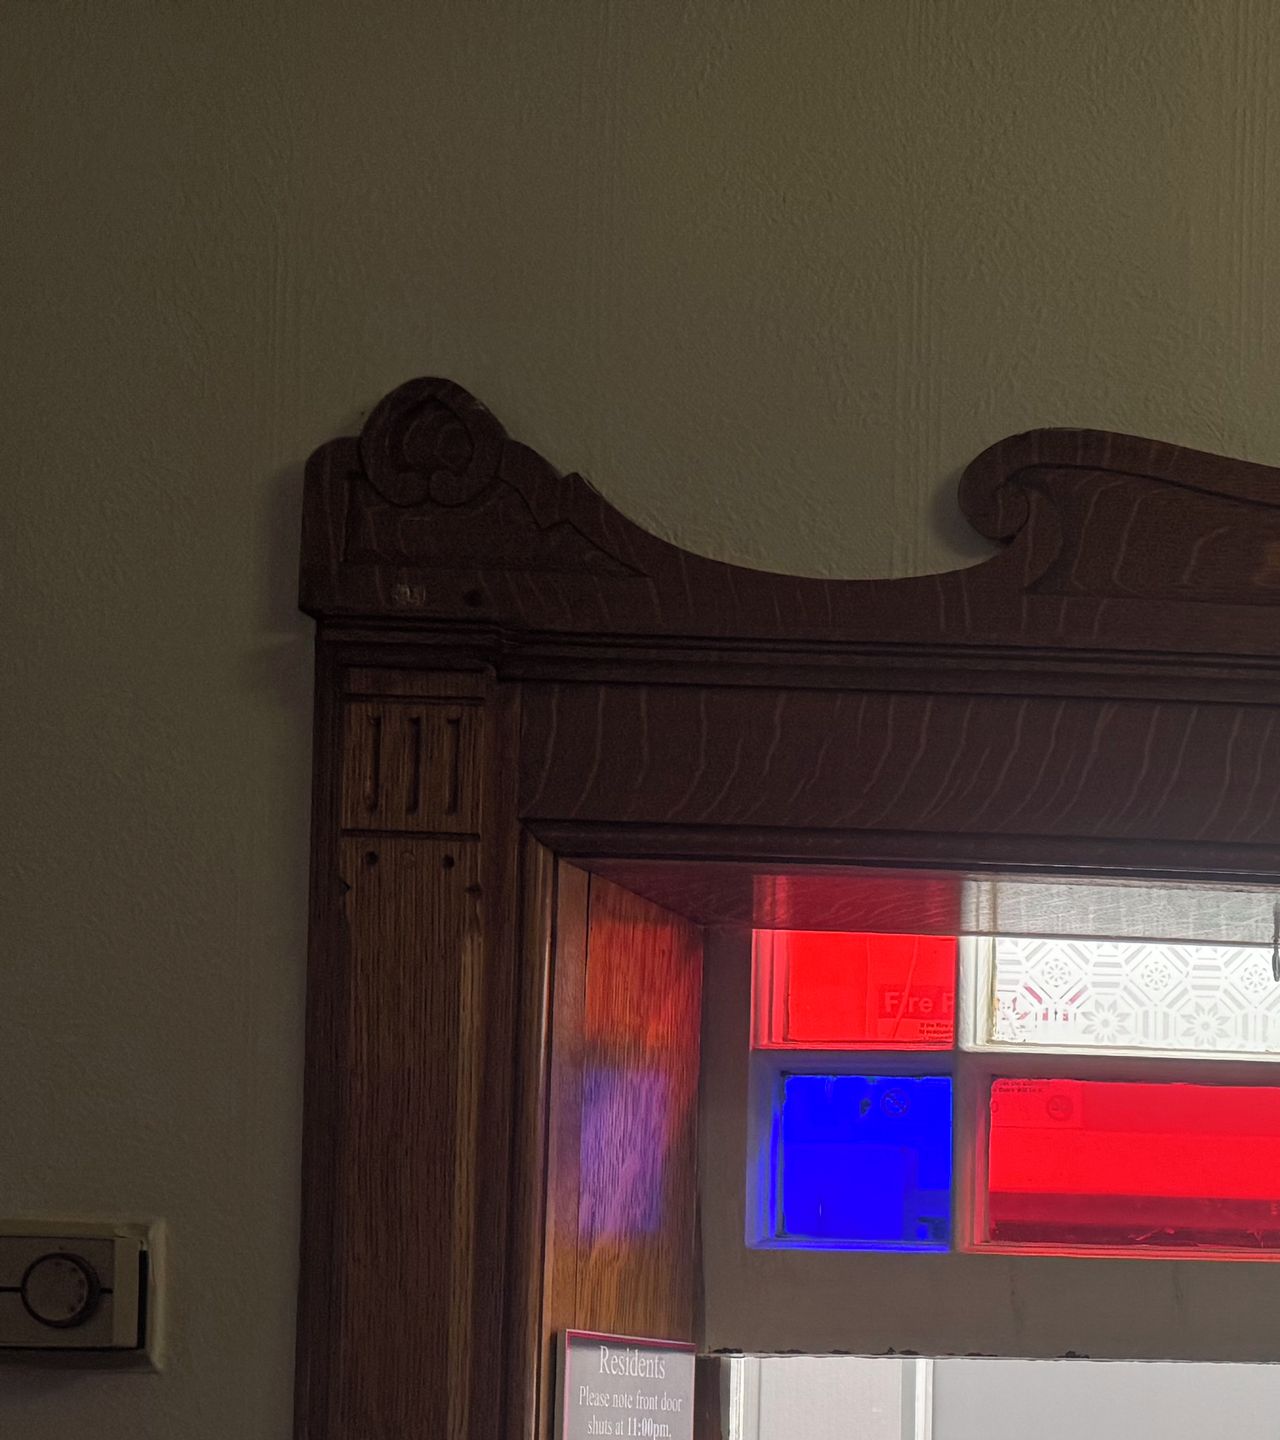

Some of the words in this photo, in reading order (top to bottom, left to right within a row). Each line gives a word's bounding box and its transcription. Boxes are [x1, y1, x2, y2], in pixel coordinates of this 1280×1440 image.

[599, 1345, 666, 1379] Residents
[579, 1385, 610, 1408] Please
[612, 1392, 633, 1409] note
[635, 1391, 658, 1410] front
[660, 1391, 682, 1412] door
[587, 1415, 612, 1436] shuts
[615, 1419, 624, 1435] at
